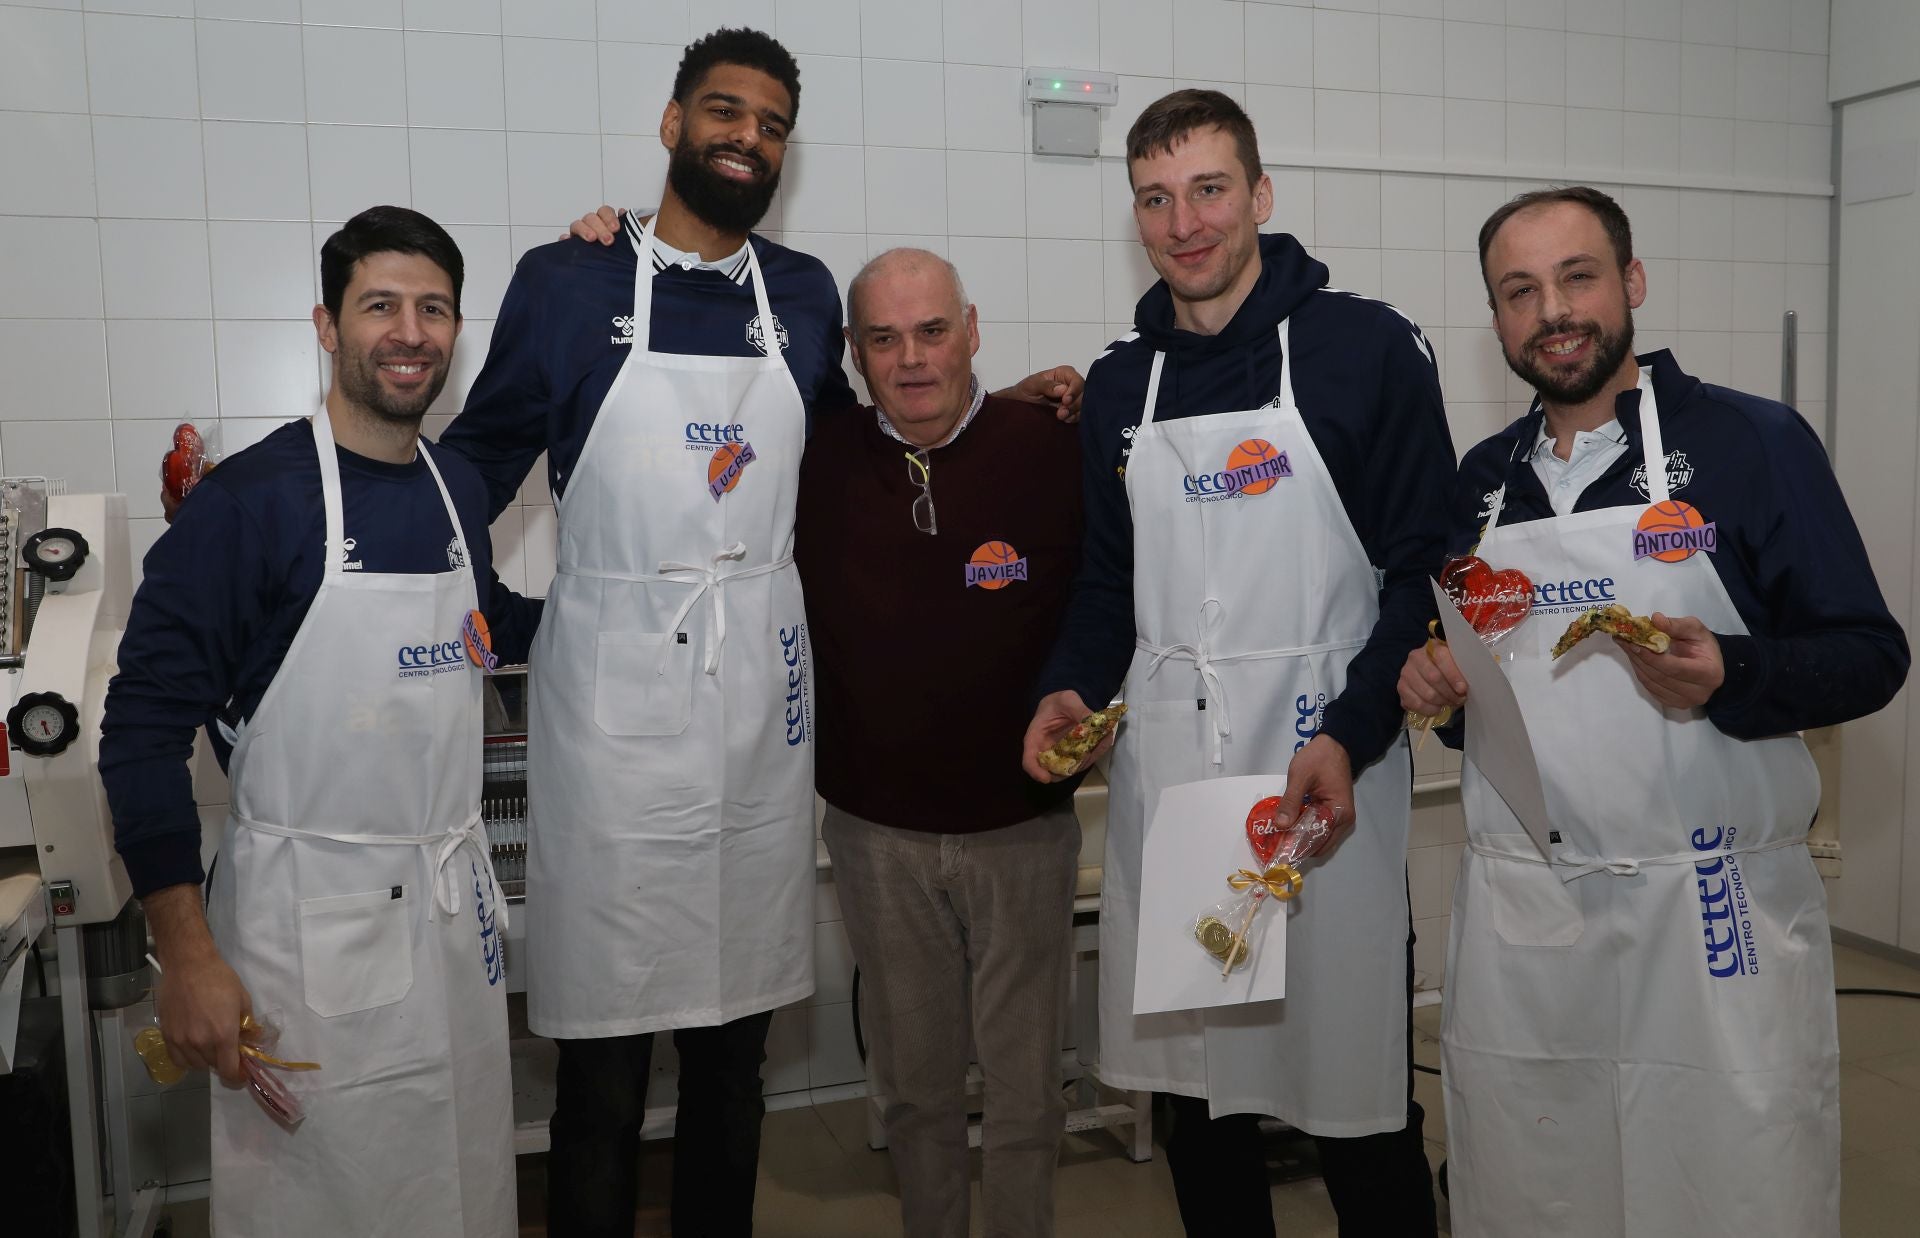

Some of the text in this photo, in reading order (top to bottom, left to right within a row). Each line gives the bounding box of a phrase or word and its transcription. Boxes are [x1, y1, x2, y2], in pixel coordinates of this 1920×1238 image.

[685, 444, 714, 452] CENTRO
[712, 447, 752, 497] LUCAS
[1224, 454, 1292, 492] DIMITAR
[1635, 527, 1716, 555] ANTONIO
[968, 562, 1026, 582] JAVIER
[465, 614, 497, 670] ALBERTO
[398, 670, 430, 678] CENTRO
[780, 625, 802, 746] cetece
[1742, 920, 1759, 975] CENTRO
